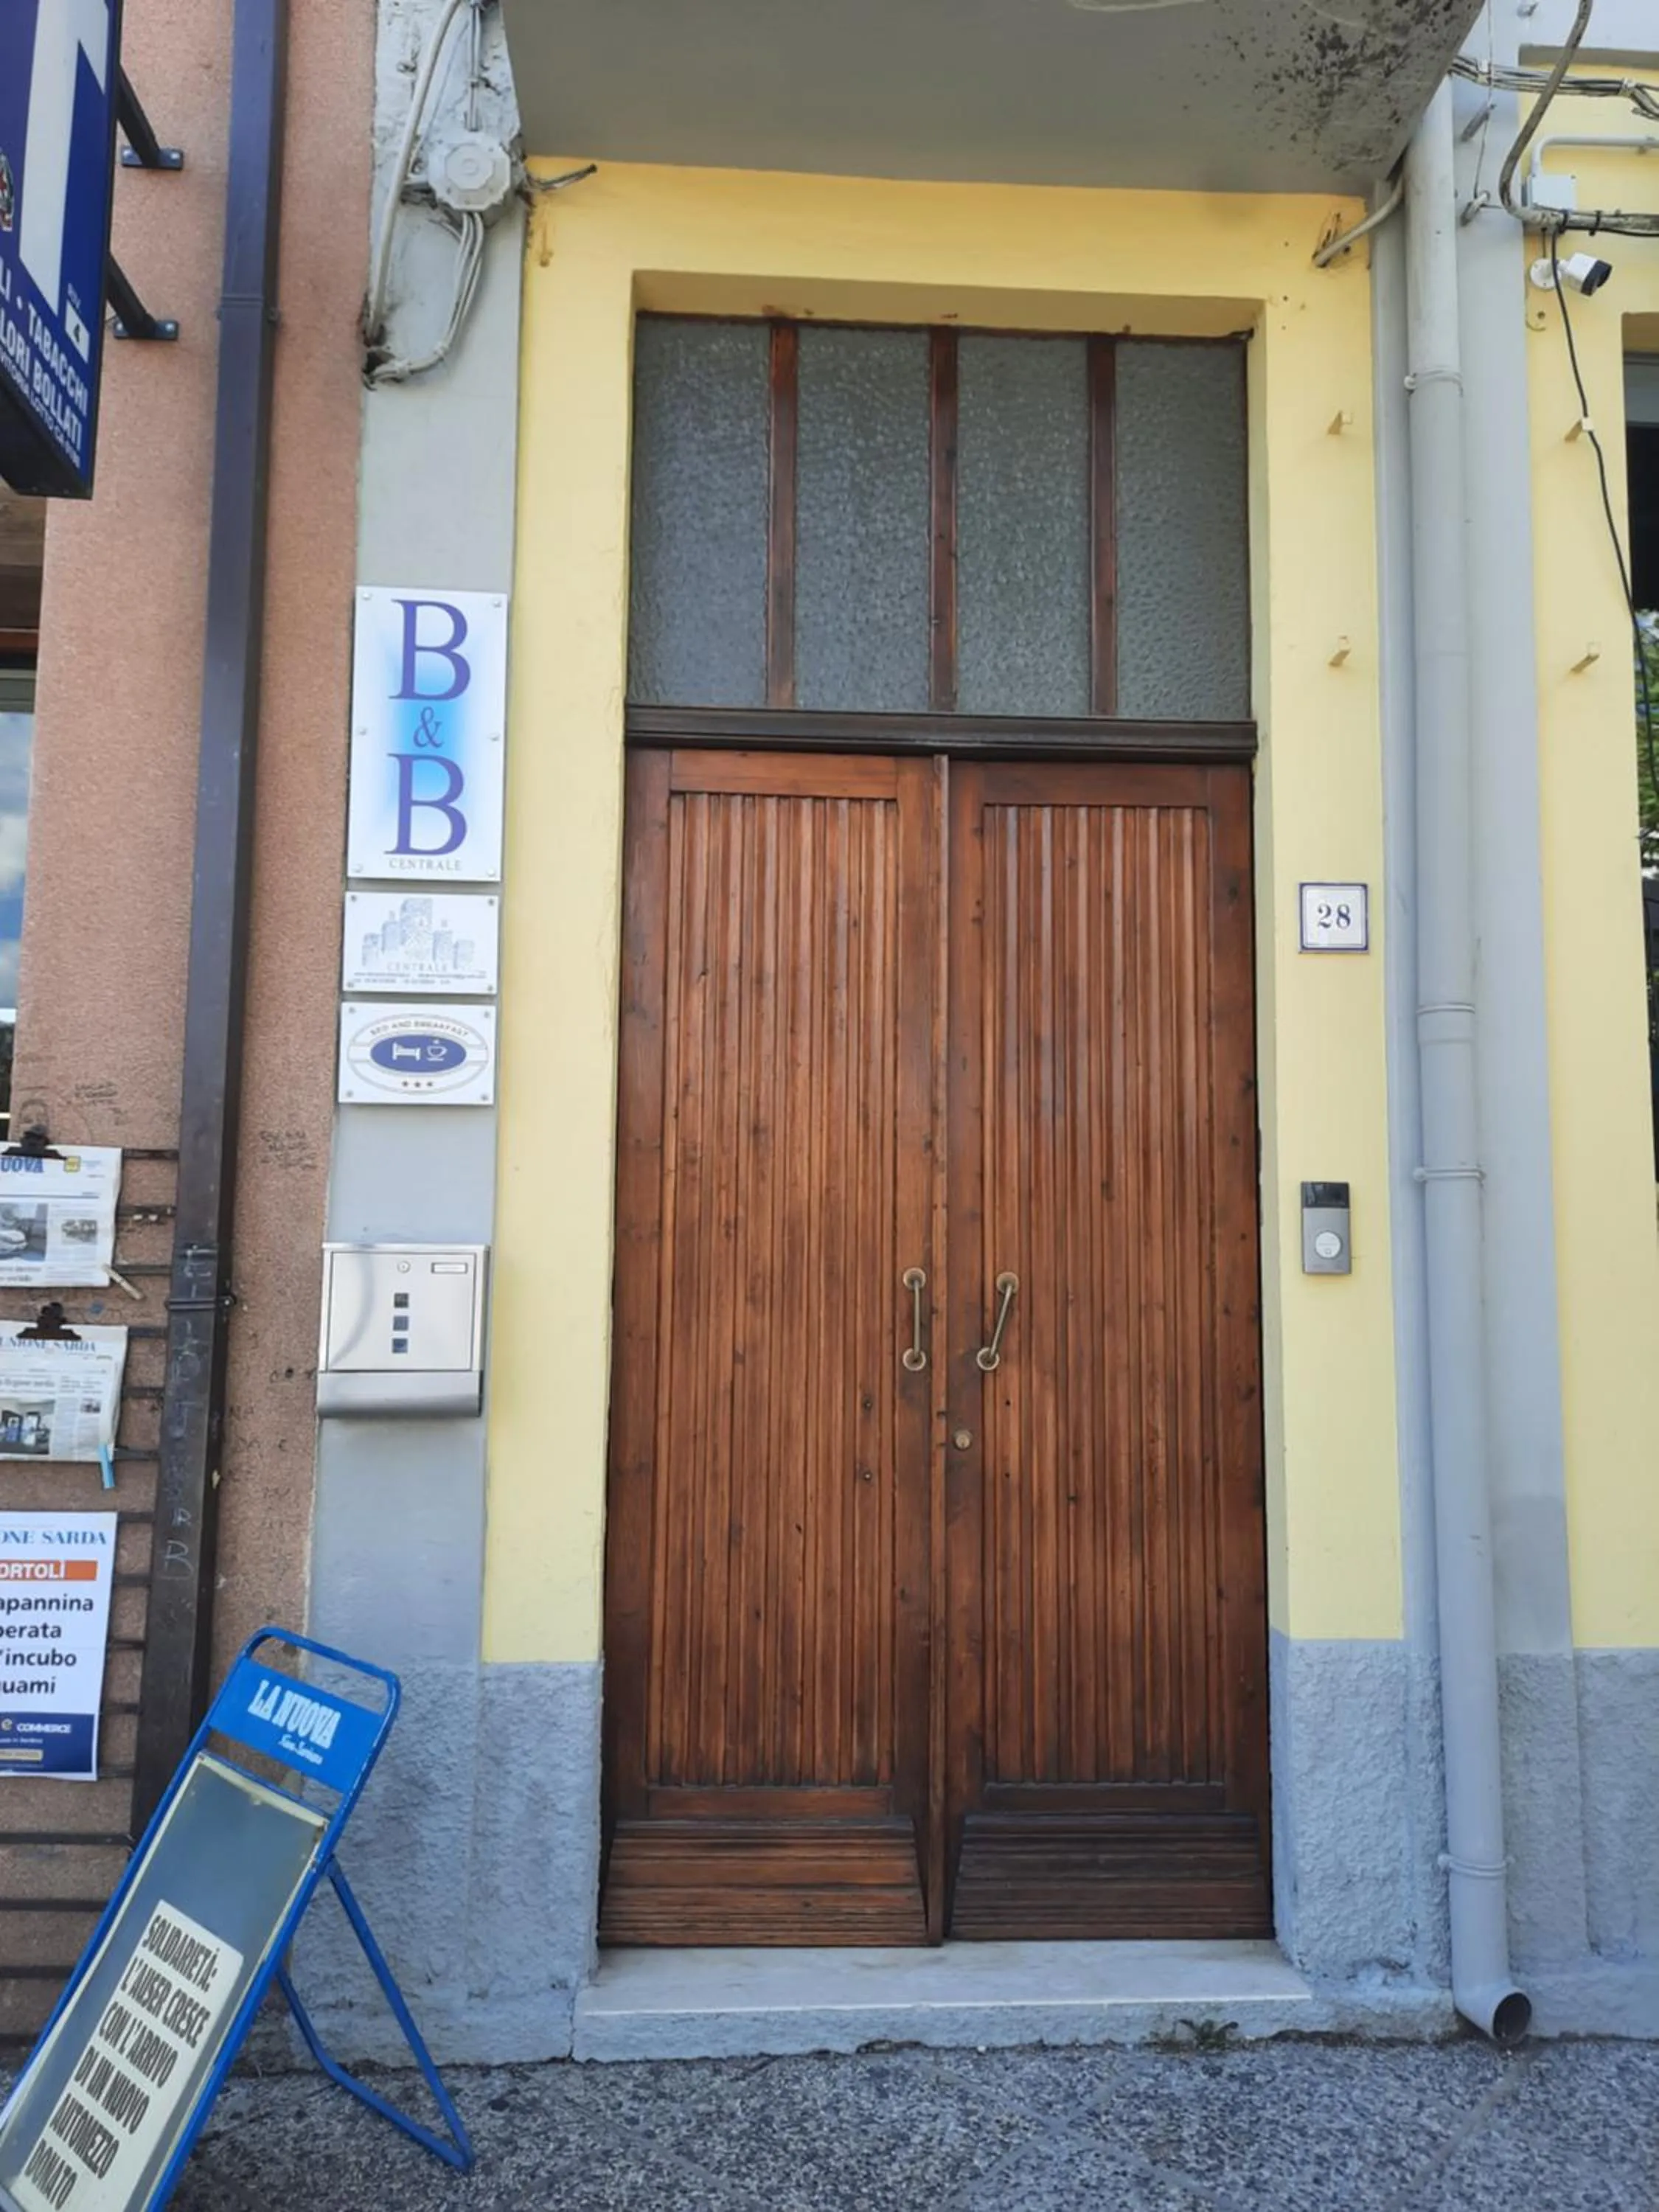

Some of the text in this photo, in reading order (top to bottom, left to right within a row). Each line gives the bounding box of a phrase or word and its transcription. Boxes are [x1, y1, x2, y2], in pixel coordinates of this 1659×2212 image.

[28, 302, 88, 417] TABACCHI
[33, 358, 82, 452] BOLLATI
[389, 599, 470, 701] B
[413, 706, 444, 749] &
[384, 753, 467, 856] B
[389, 858, 462, 872] CENTRALE
[1318, 903, 1352, 930] 28
[42, 1531, 107, 1545] SARDA
[0, 1676, 56, 1694] uami
[248, 1679, 341, 1749] LA NUOVA
[99, 2000, 179, 2089] CON L'ARRIVO
[162, 1988, 212, 2049] CRESCE
[74, 2045, 150, 2135] DI UN NUOVO
[49, 2092, 120, 2180] AUTOMEZZO
[25, 2137, 78, 2211] DONATO
